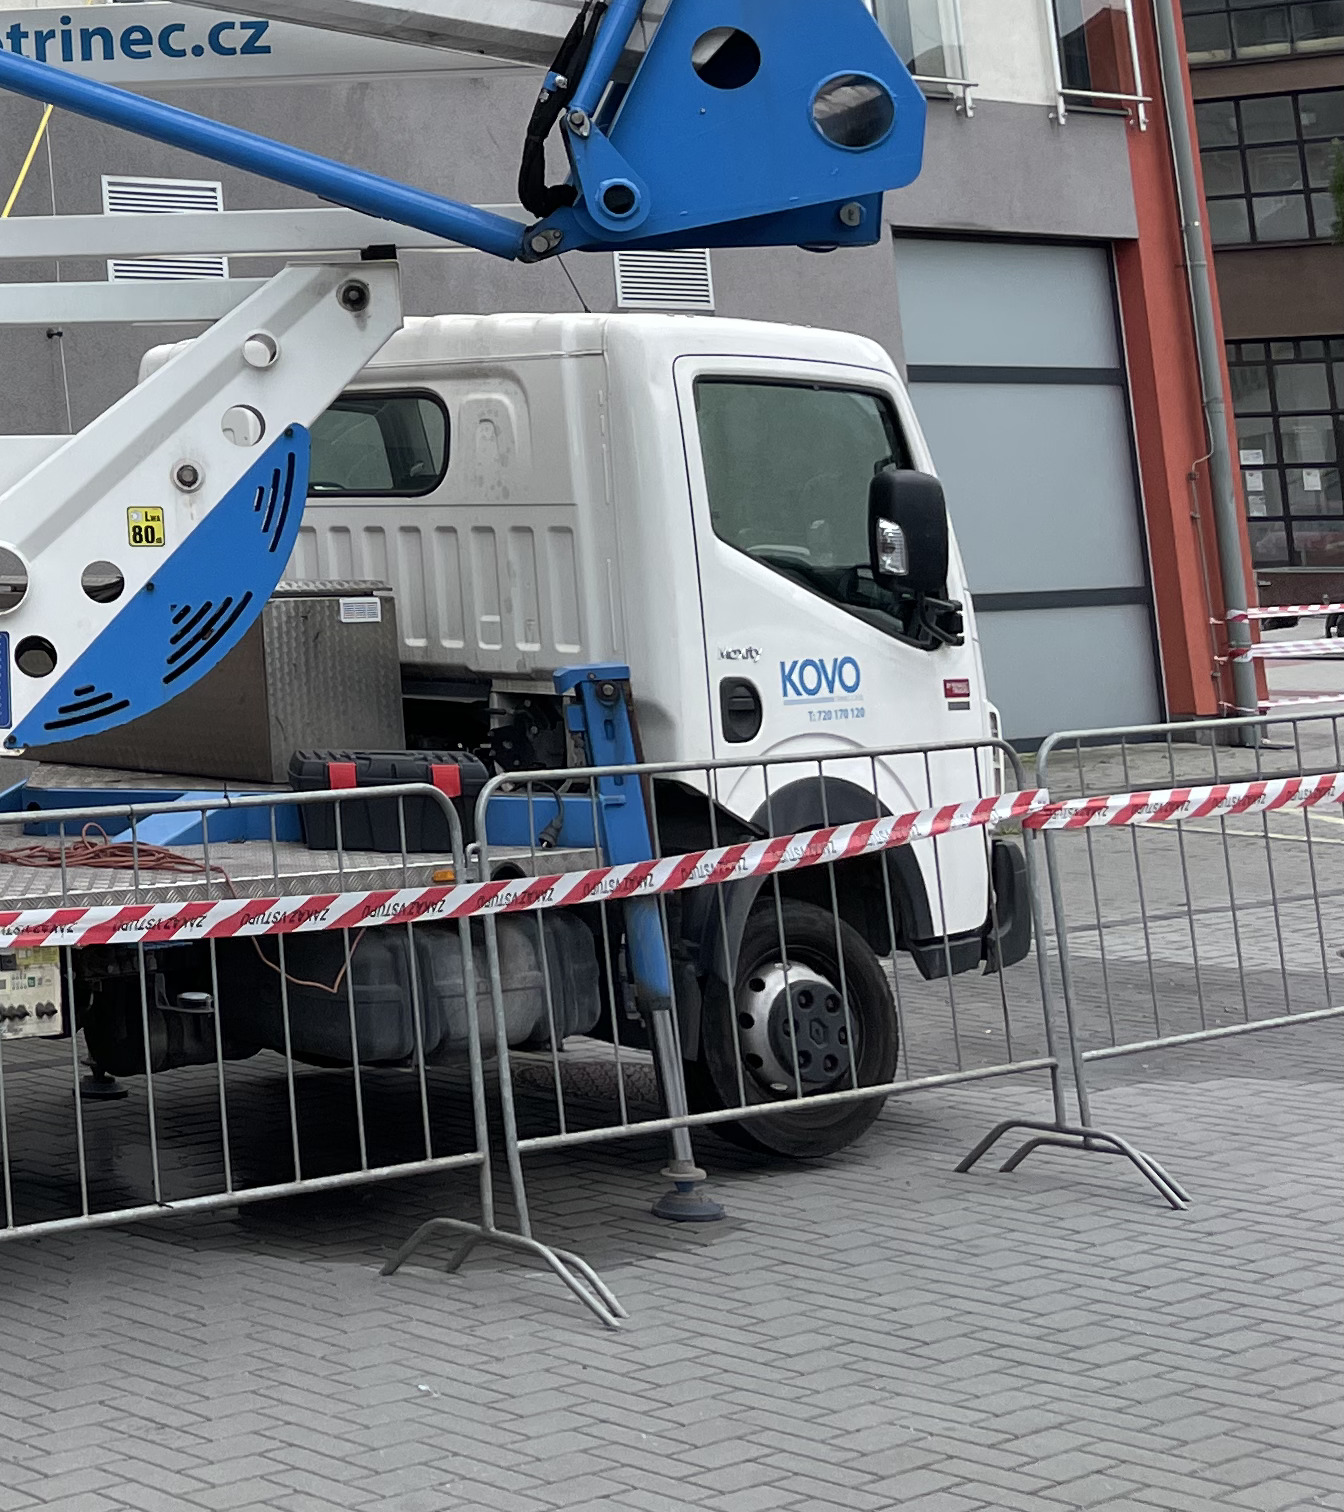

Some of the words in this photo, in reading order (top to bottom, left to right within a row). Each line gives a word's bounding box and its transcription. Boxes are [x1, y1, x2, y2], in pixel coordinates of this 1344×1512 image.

[132, 525, 156, 544] 80
[779, 656, 861, 697] KOVO
[851, 707, 865, 718] 120
